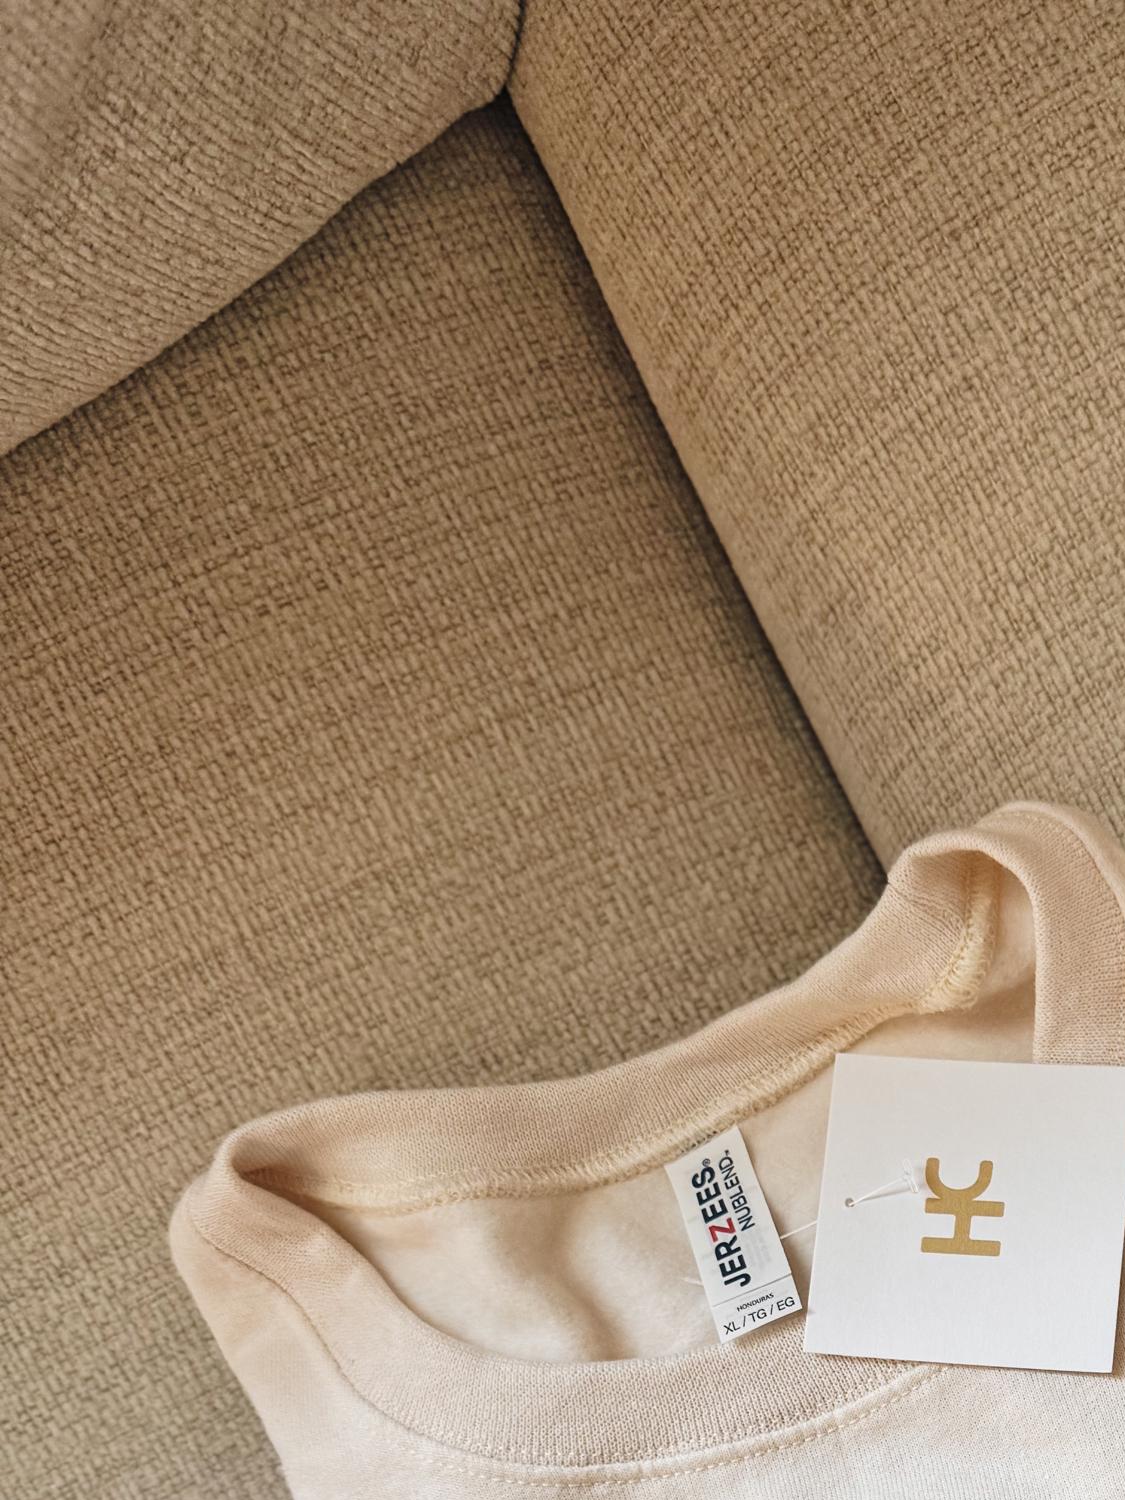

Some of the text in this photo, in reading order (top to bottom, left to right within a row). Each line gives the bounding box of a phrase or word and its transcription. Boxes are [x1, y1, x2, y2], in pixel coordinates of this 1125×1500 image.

[724, 1320, 741, 1335] XL
[748, 1307, 768, 1323] TG
[777, 1296, 796, 1312] EG
[736, 1292, 775, 1312] HONDURAS
